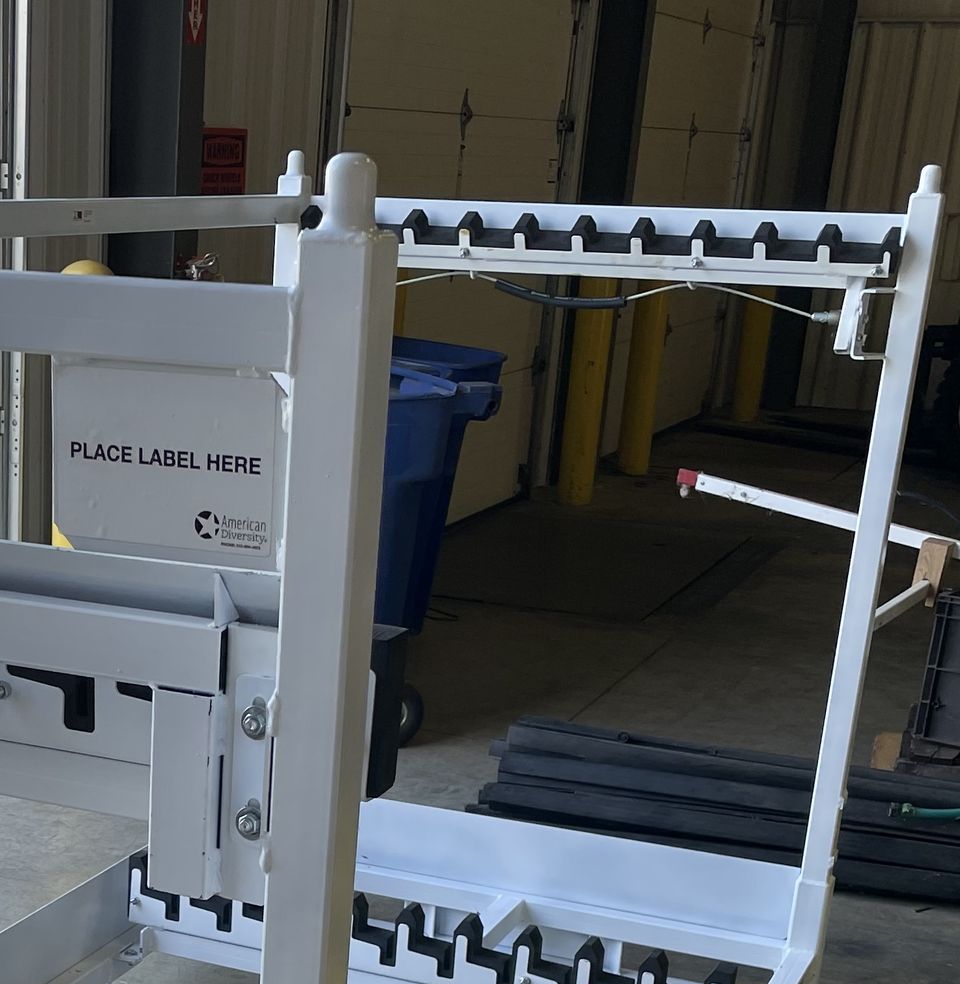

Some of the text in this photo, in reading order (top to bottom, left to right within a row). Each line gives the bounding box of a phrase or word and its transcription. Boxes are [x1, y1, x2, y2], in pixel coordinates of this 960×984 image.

[206, 142, 240, 161] WARNING
[70, 441, 261, 475] PLACE LABEL HERE
[221, 515, 267, 532] American
